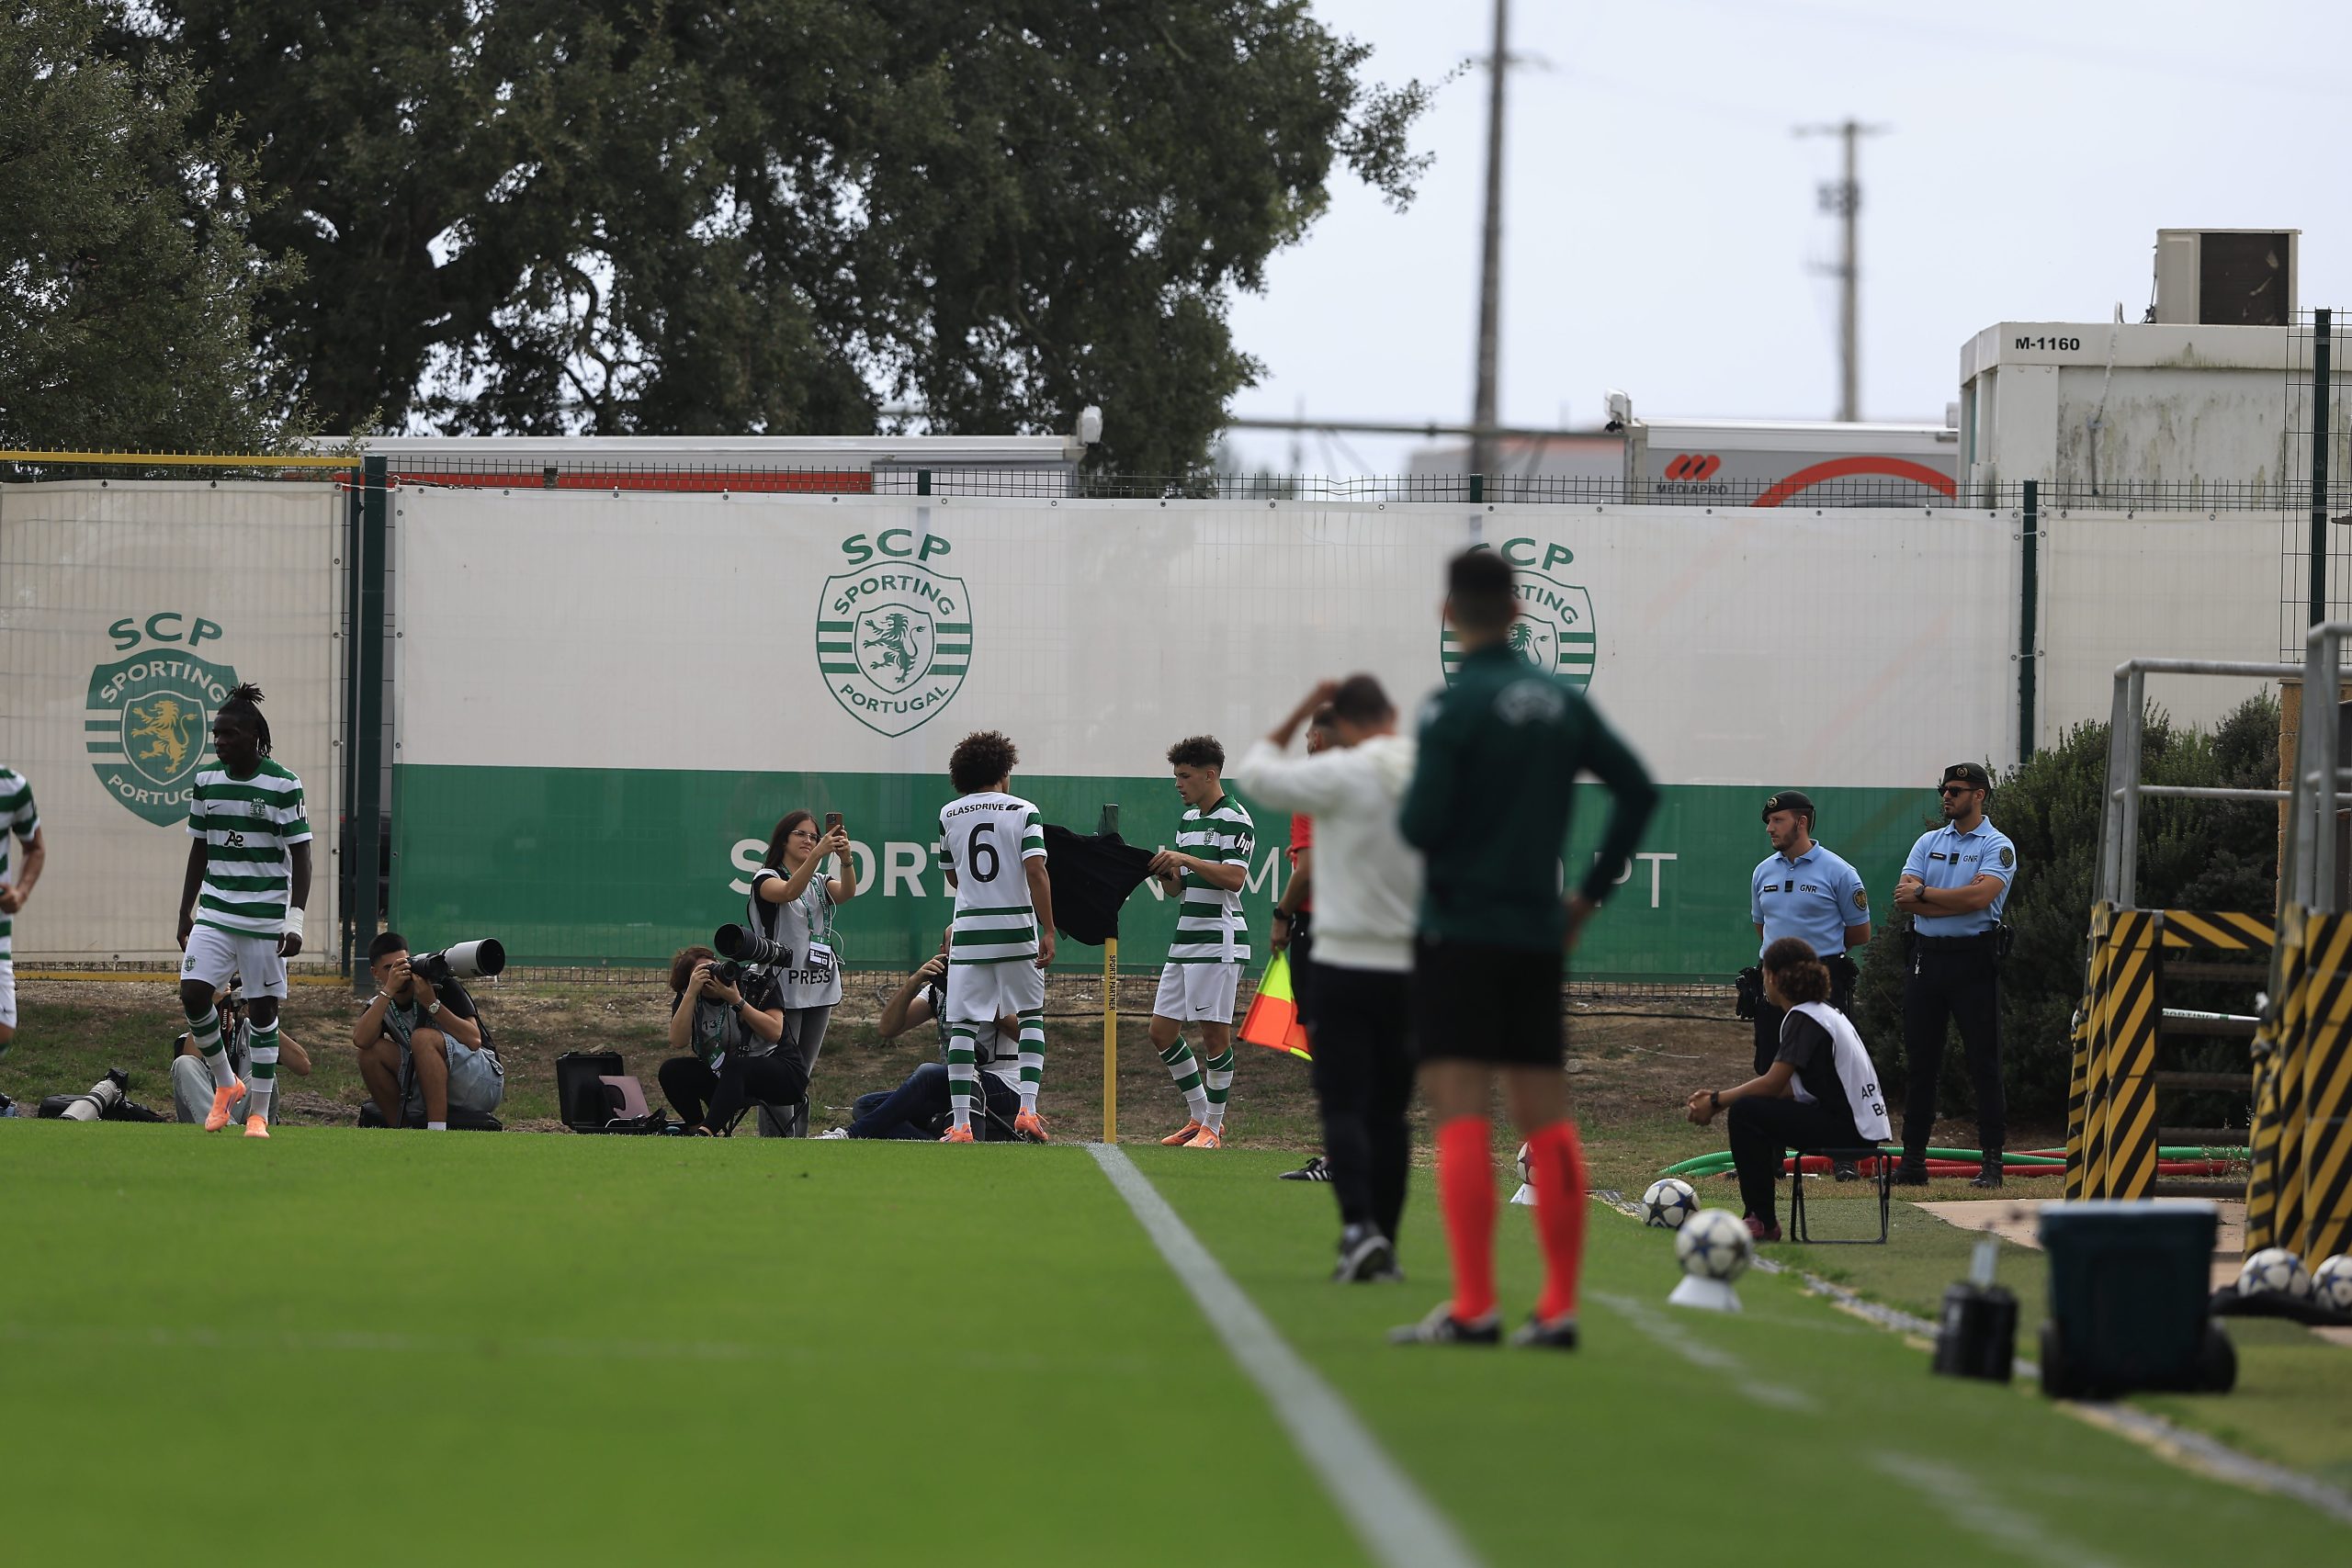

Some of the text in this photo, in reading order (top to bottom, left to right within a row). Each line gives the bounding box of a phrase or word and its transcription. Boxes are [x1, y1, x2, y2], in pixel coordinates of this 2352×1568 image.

[2015, 336, 2080, 351] M-1160
[1656, 483, 1728, 495] MEDIAPRO
[841, 528, 952, 566] SCP
[1467, 537, 1575, 571] CP
[833, 574, 956, 616] SPORTING
[1510, 583, 1579, 626] RTING
[108, 612, 223, 651] SCP
[100, 660, 231, 705] SPORTING
[839, 682, 950, 715] PORTUGAL
[107, 773, 194, 807] PORTUG
[945, 803, 1005, 818] GLASSDRIVE
[968, 822, 1000, 883] 6
[1235, 831, 1251, 855] hp
[1962, 854, 1978, 863] GNR
[1800, 884, 1817, 894] GNR
[788, 969, 831, 985] PRESS
[1861, 1083, 1881, 1100] AP
